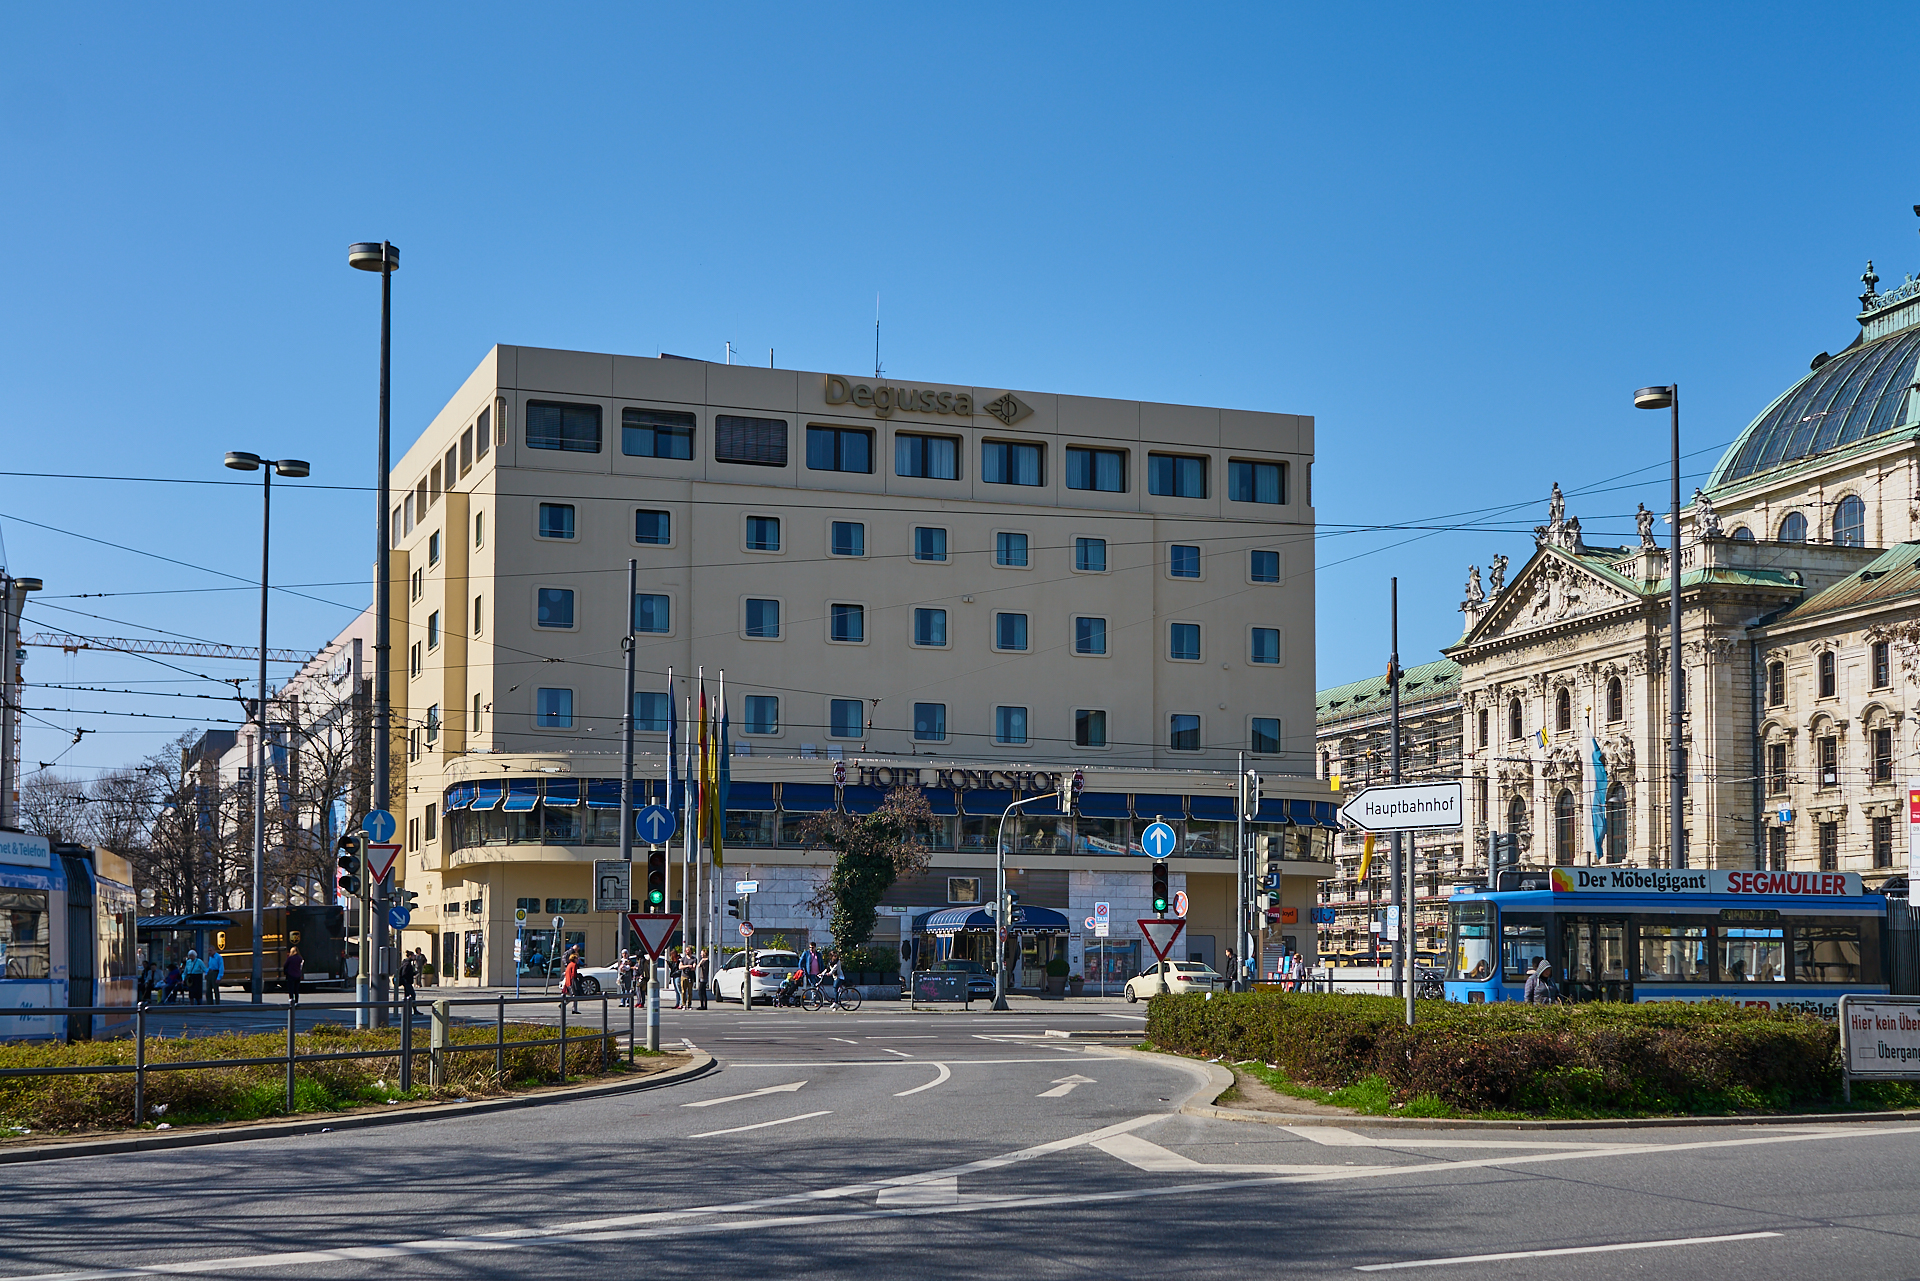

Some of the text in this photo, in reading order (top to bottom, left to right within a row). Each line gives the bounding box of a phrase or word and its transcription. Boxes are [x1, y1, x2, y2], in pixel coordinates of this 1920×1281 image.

[825, 374, 973, 417] Degussa
[858, 766, 929, 789] HOTEL
[1365, 796, 1454, 817] Hauptbahnhof
[18, 843, 47, 858] Telefon
[1577, 871, 1847, 895] Der Möbelgigant SEGMÜLLER
[1851, 1014, 1872, 1030] Hier
[1875, 1014, 1897, 1030] kein
